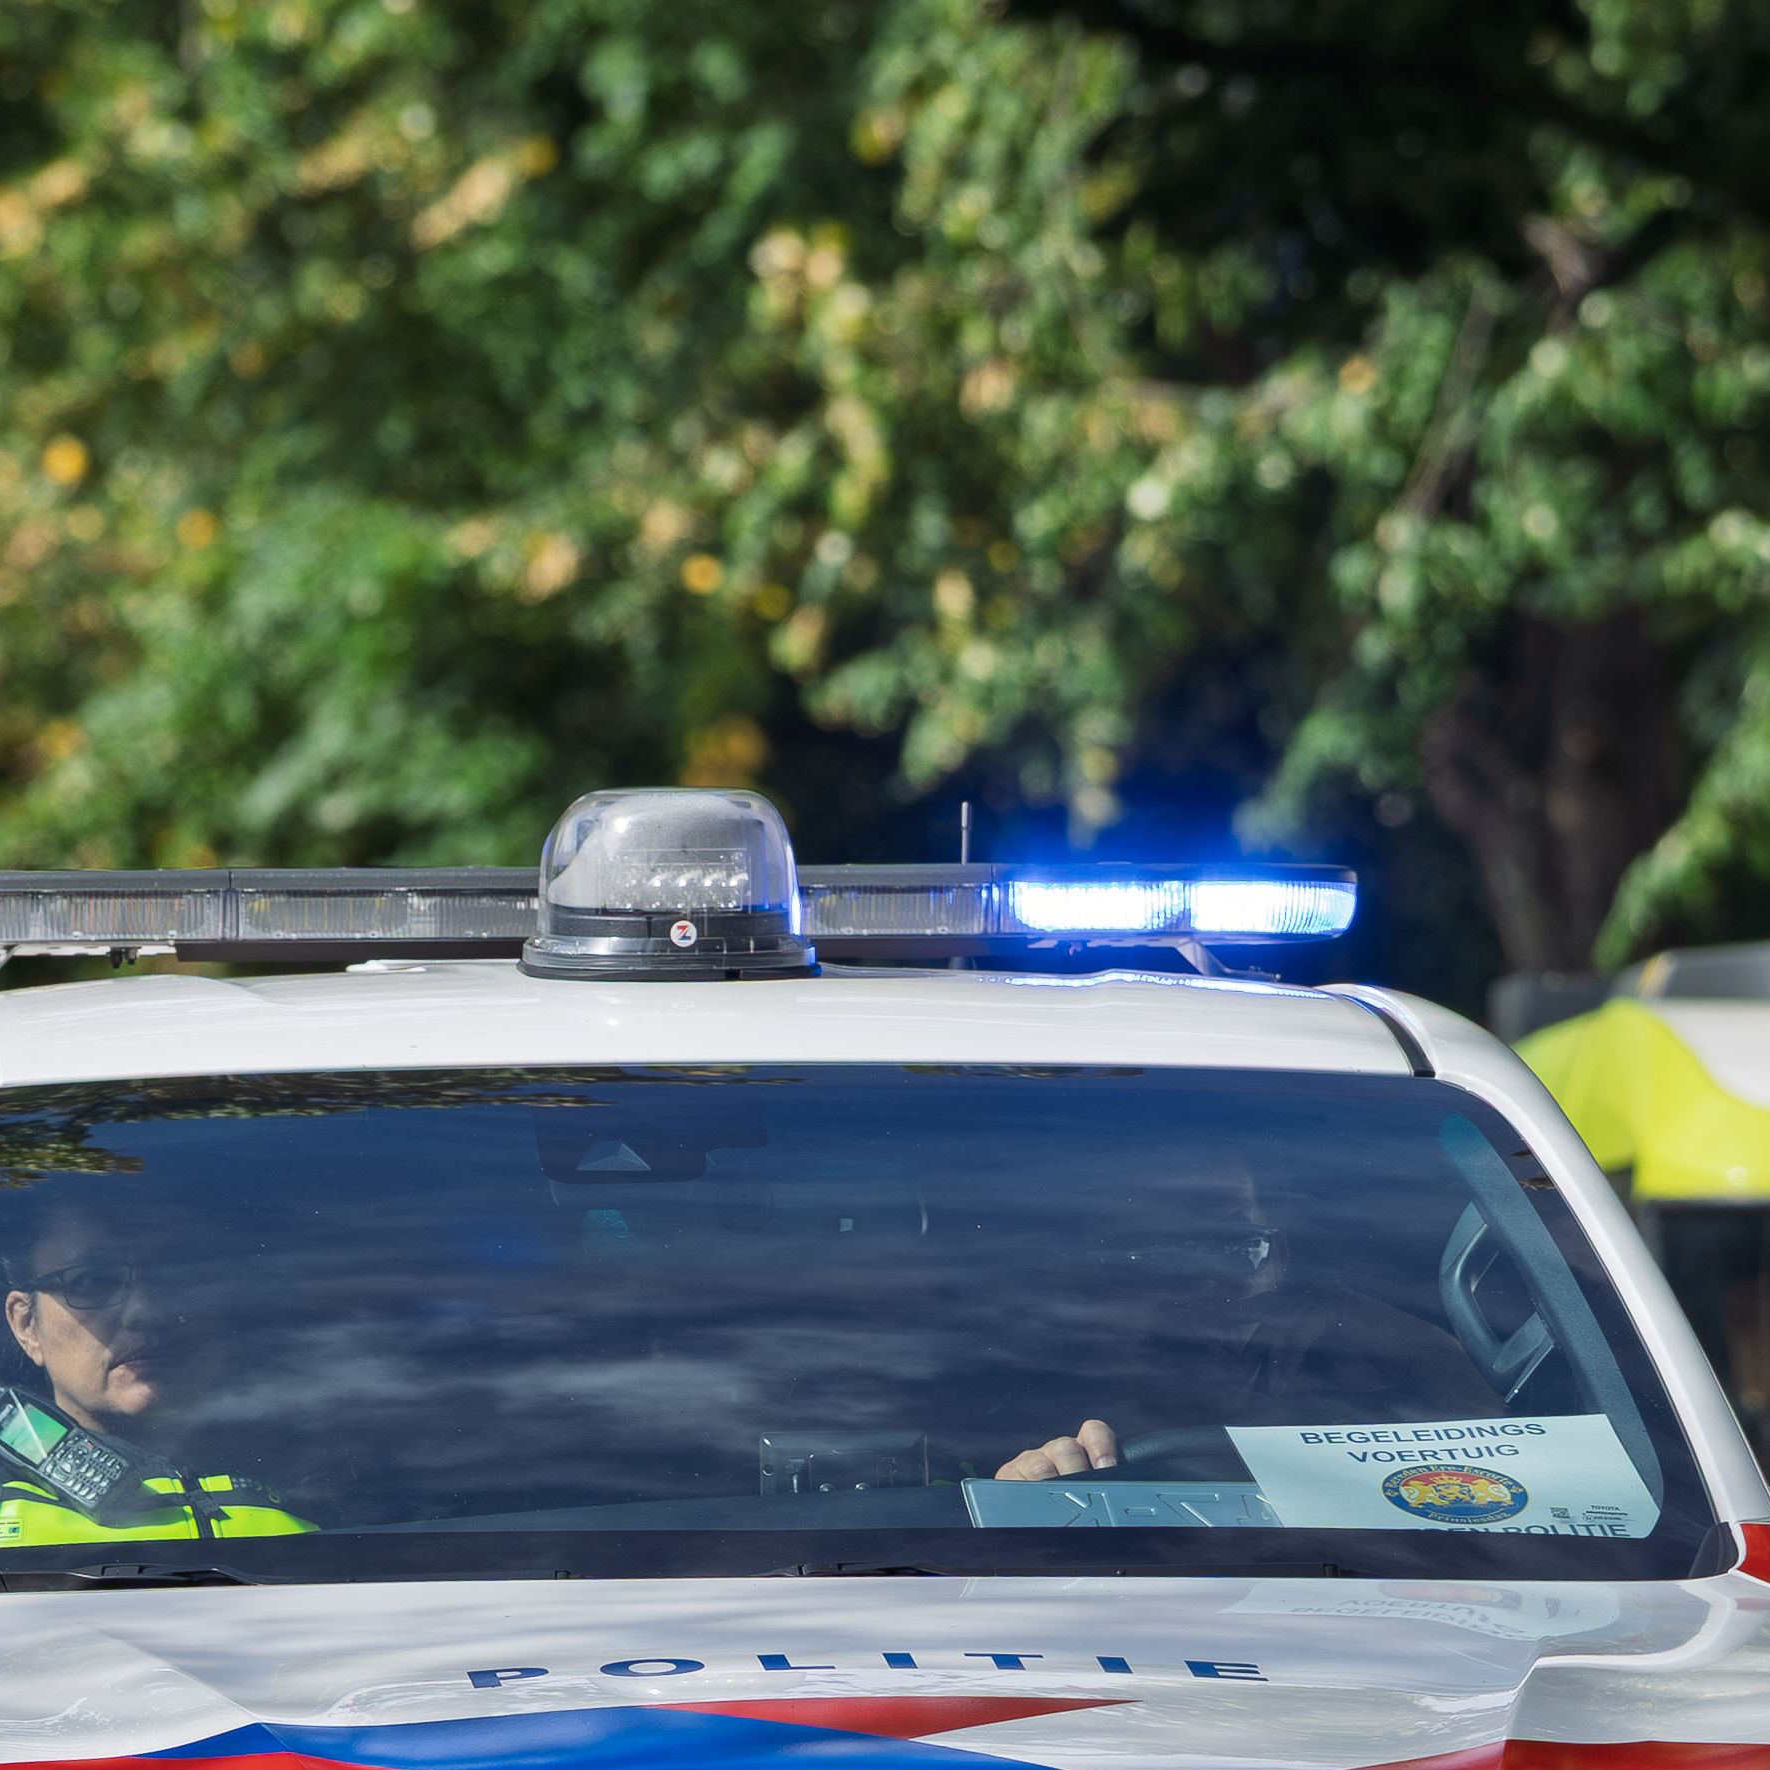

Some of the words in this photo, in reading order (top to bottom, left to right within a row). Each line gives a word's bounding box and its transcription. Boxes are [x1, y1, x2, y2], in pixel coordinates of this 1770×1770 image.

[1300, 1423, 1546, 1445] BEGELEIDINGS
[1347, 1444, 1520, 1463] VOERTUIG
[465, 1652, 1270, 1689] POLITIE
